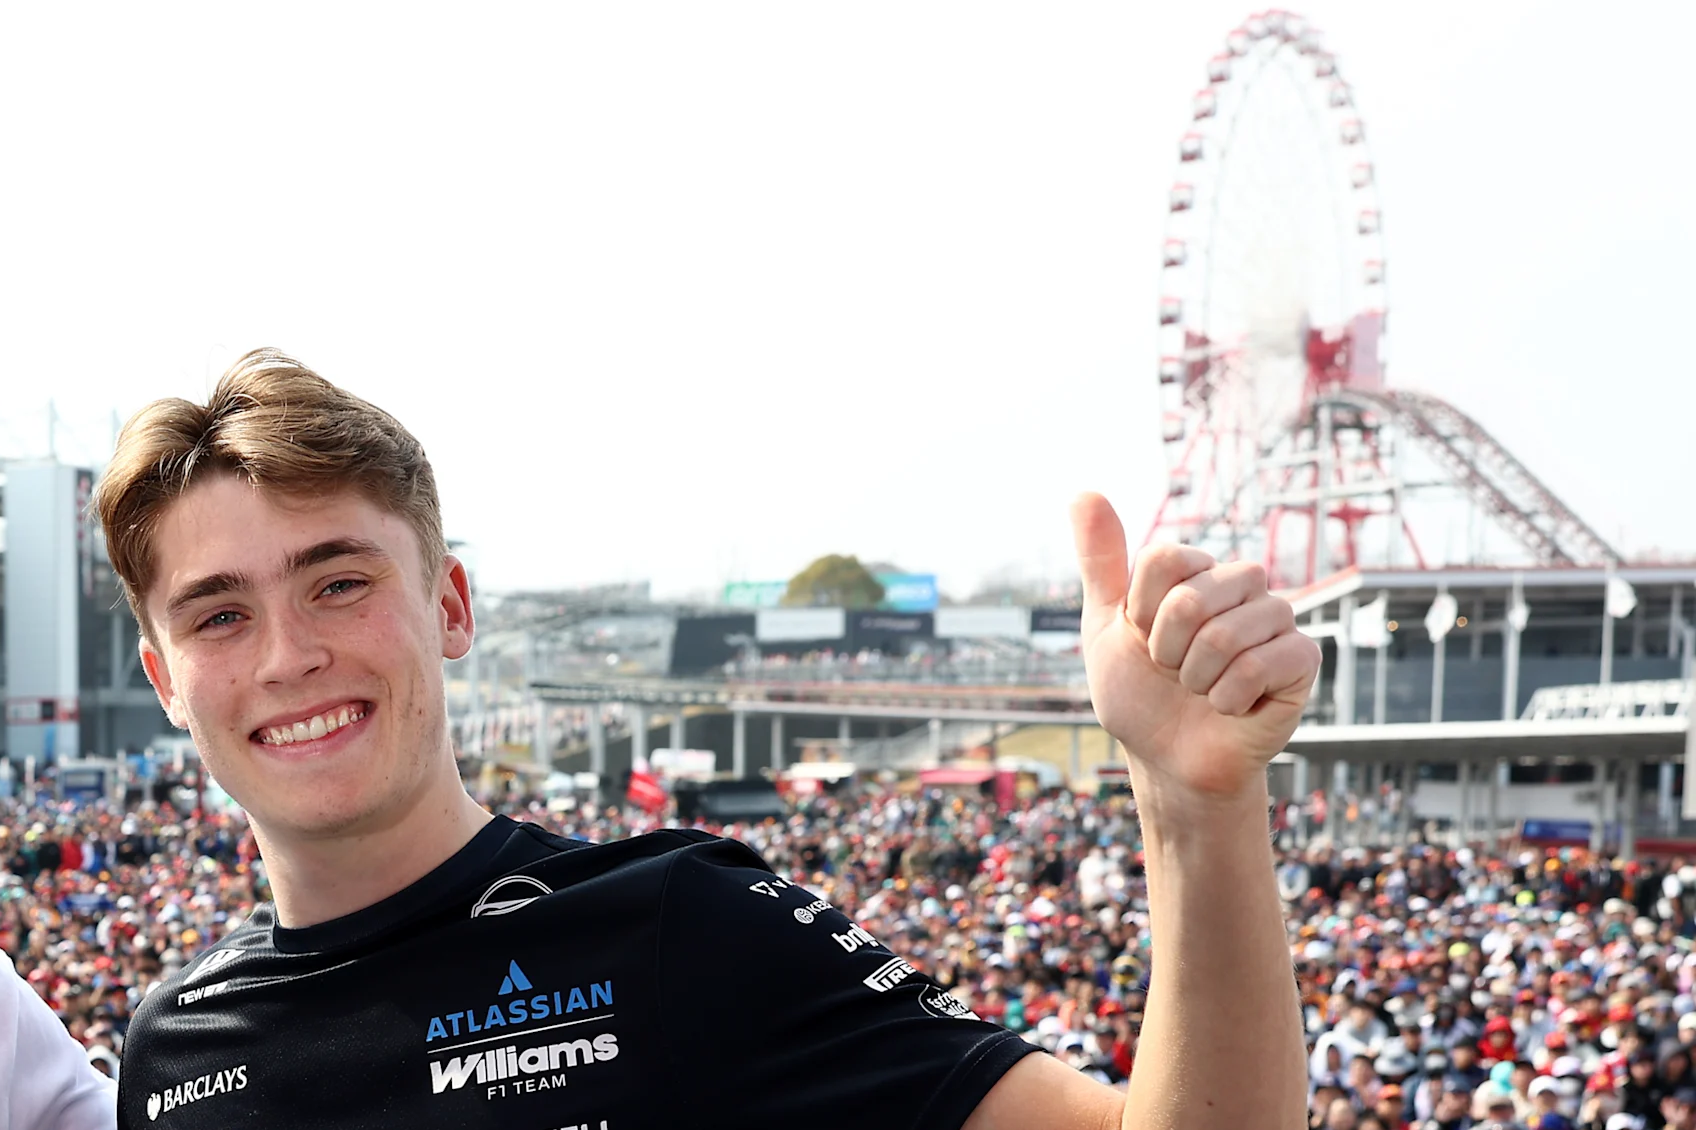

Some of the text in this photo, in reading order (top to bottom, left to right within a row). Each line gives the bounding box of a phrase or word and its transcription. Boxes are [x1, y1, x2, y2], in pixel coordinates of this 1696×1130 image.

[426, 980, 614, 1043] ATLASSIAN
[163, 1065, 248, 1113] BARCLAYS
[430, 1033, 620, 1094] Williams
[487, 1073, 567, 1100] F1 TEAM
